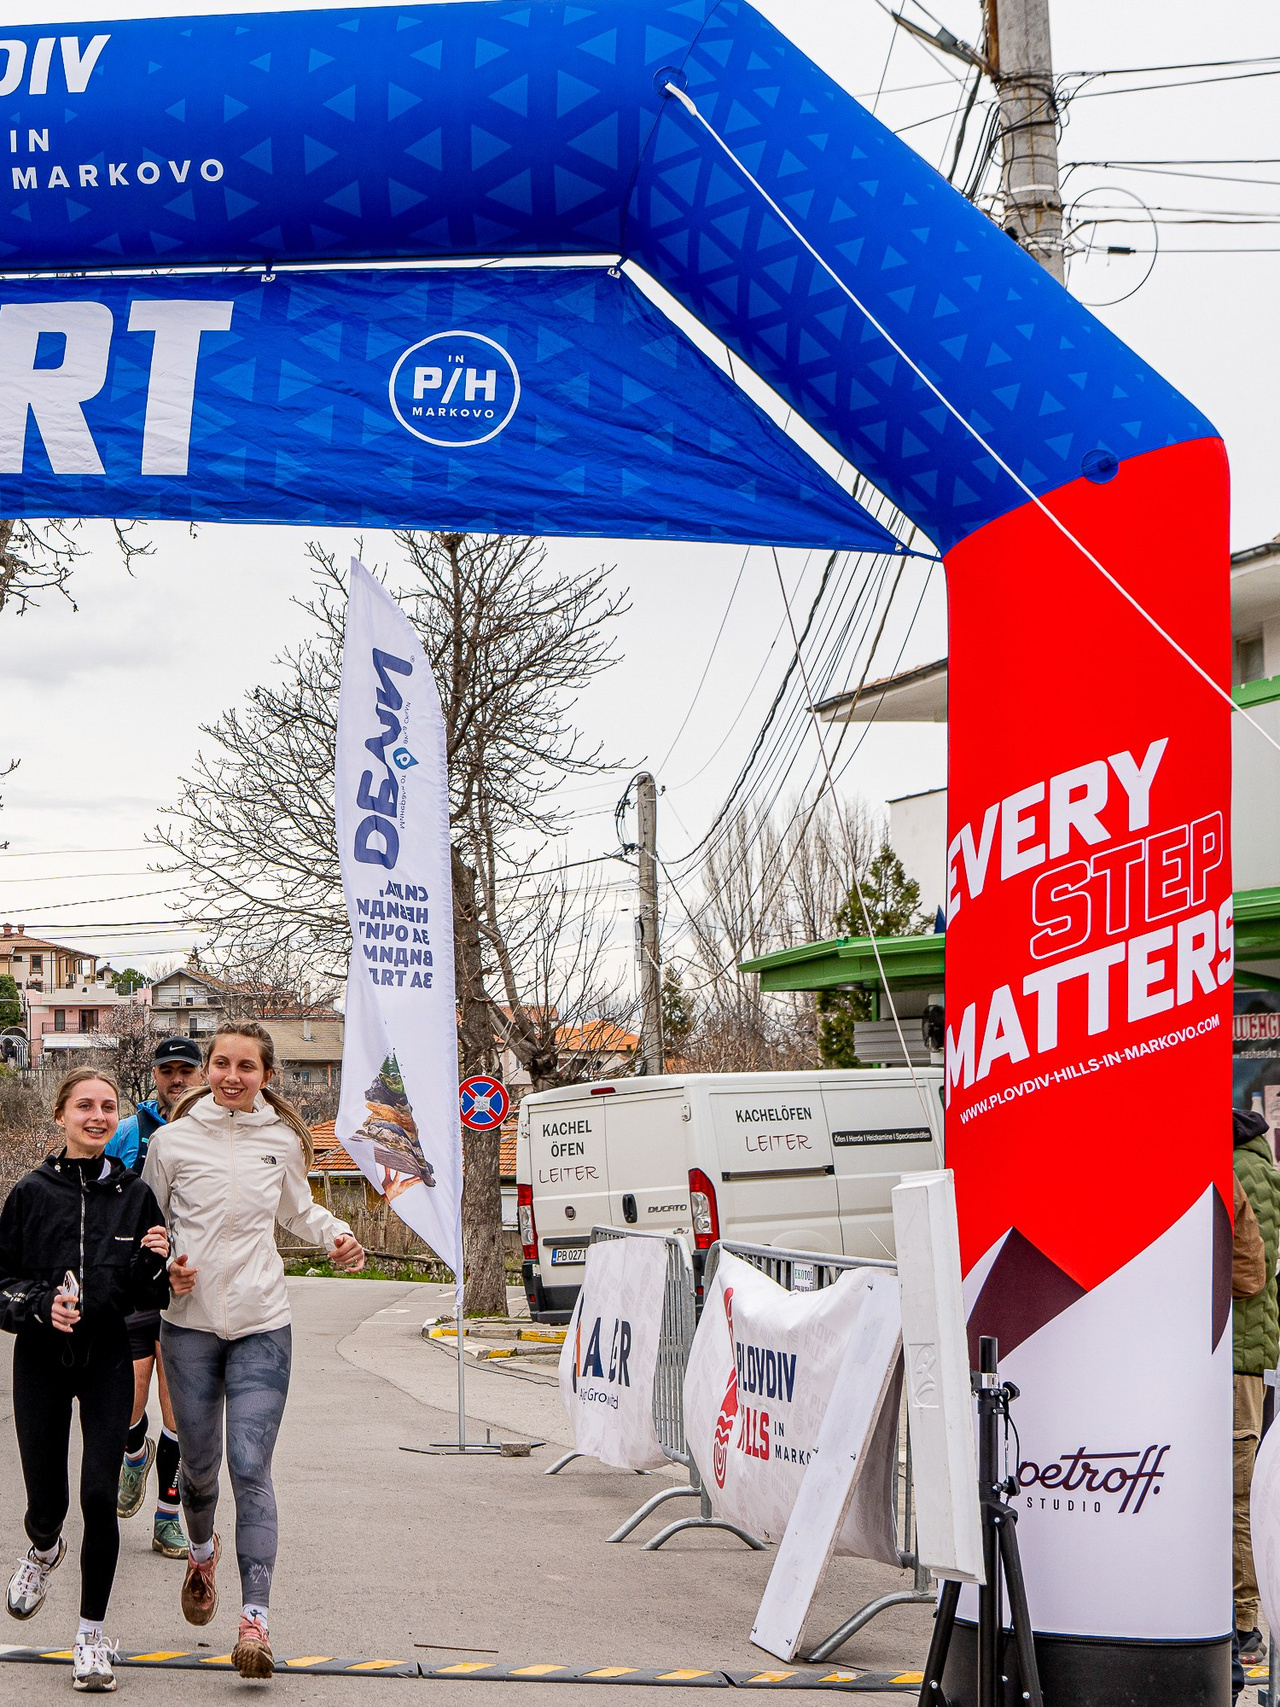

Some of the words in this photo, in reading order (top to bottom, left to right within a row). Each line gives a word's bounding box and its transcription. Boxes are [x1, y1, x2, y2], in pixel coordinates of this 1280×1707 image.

[10, 128, 50, 153] IN
[12, 158, 226, 190] MARKOVO
[448, 354, 464, 363] IN
[413, 366, 497, 404] P/H
[412, 406, 495, 418] MARKOVO
[946, 737, 1169, 930] EVERY
[1030, 810, 1223, 960] STEP
[945, 893, 1234, 1111] MATTERS
[960, 1014, 1220, 1125] WWW.PLOVDIV-HILLS-IN-MARKOVO.COM
[735, 1105, 812, 1123] KACHELÖFEN
[542, 1120, 592, 1137] KACHEL
[551, 1141, 584, 1158] ÖFEN
[745, 1134, 812, 1152] LEITER
[538, 1165, 599, 1184] LEITER
[648, 1204, 687, 1214] DUCATO
[736, 1342, 797, 1403] PLOVDIV
[774, 1421, 784, 1437] IN
[1026, 1496, 1101, 1513] STUDIO
